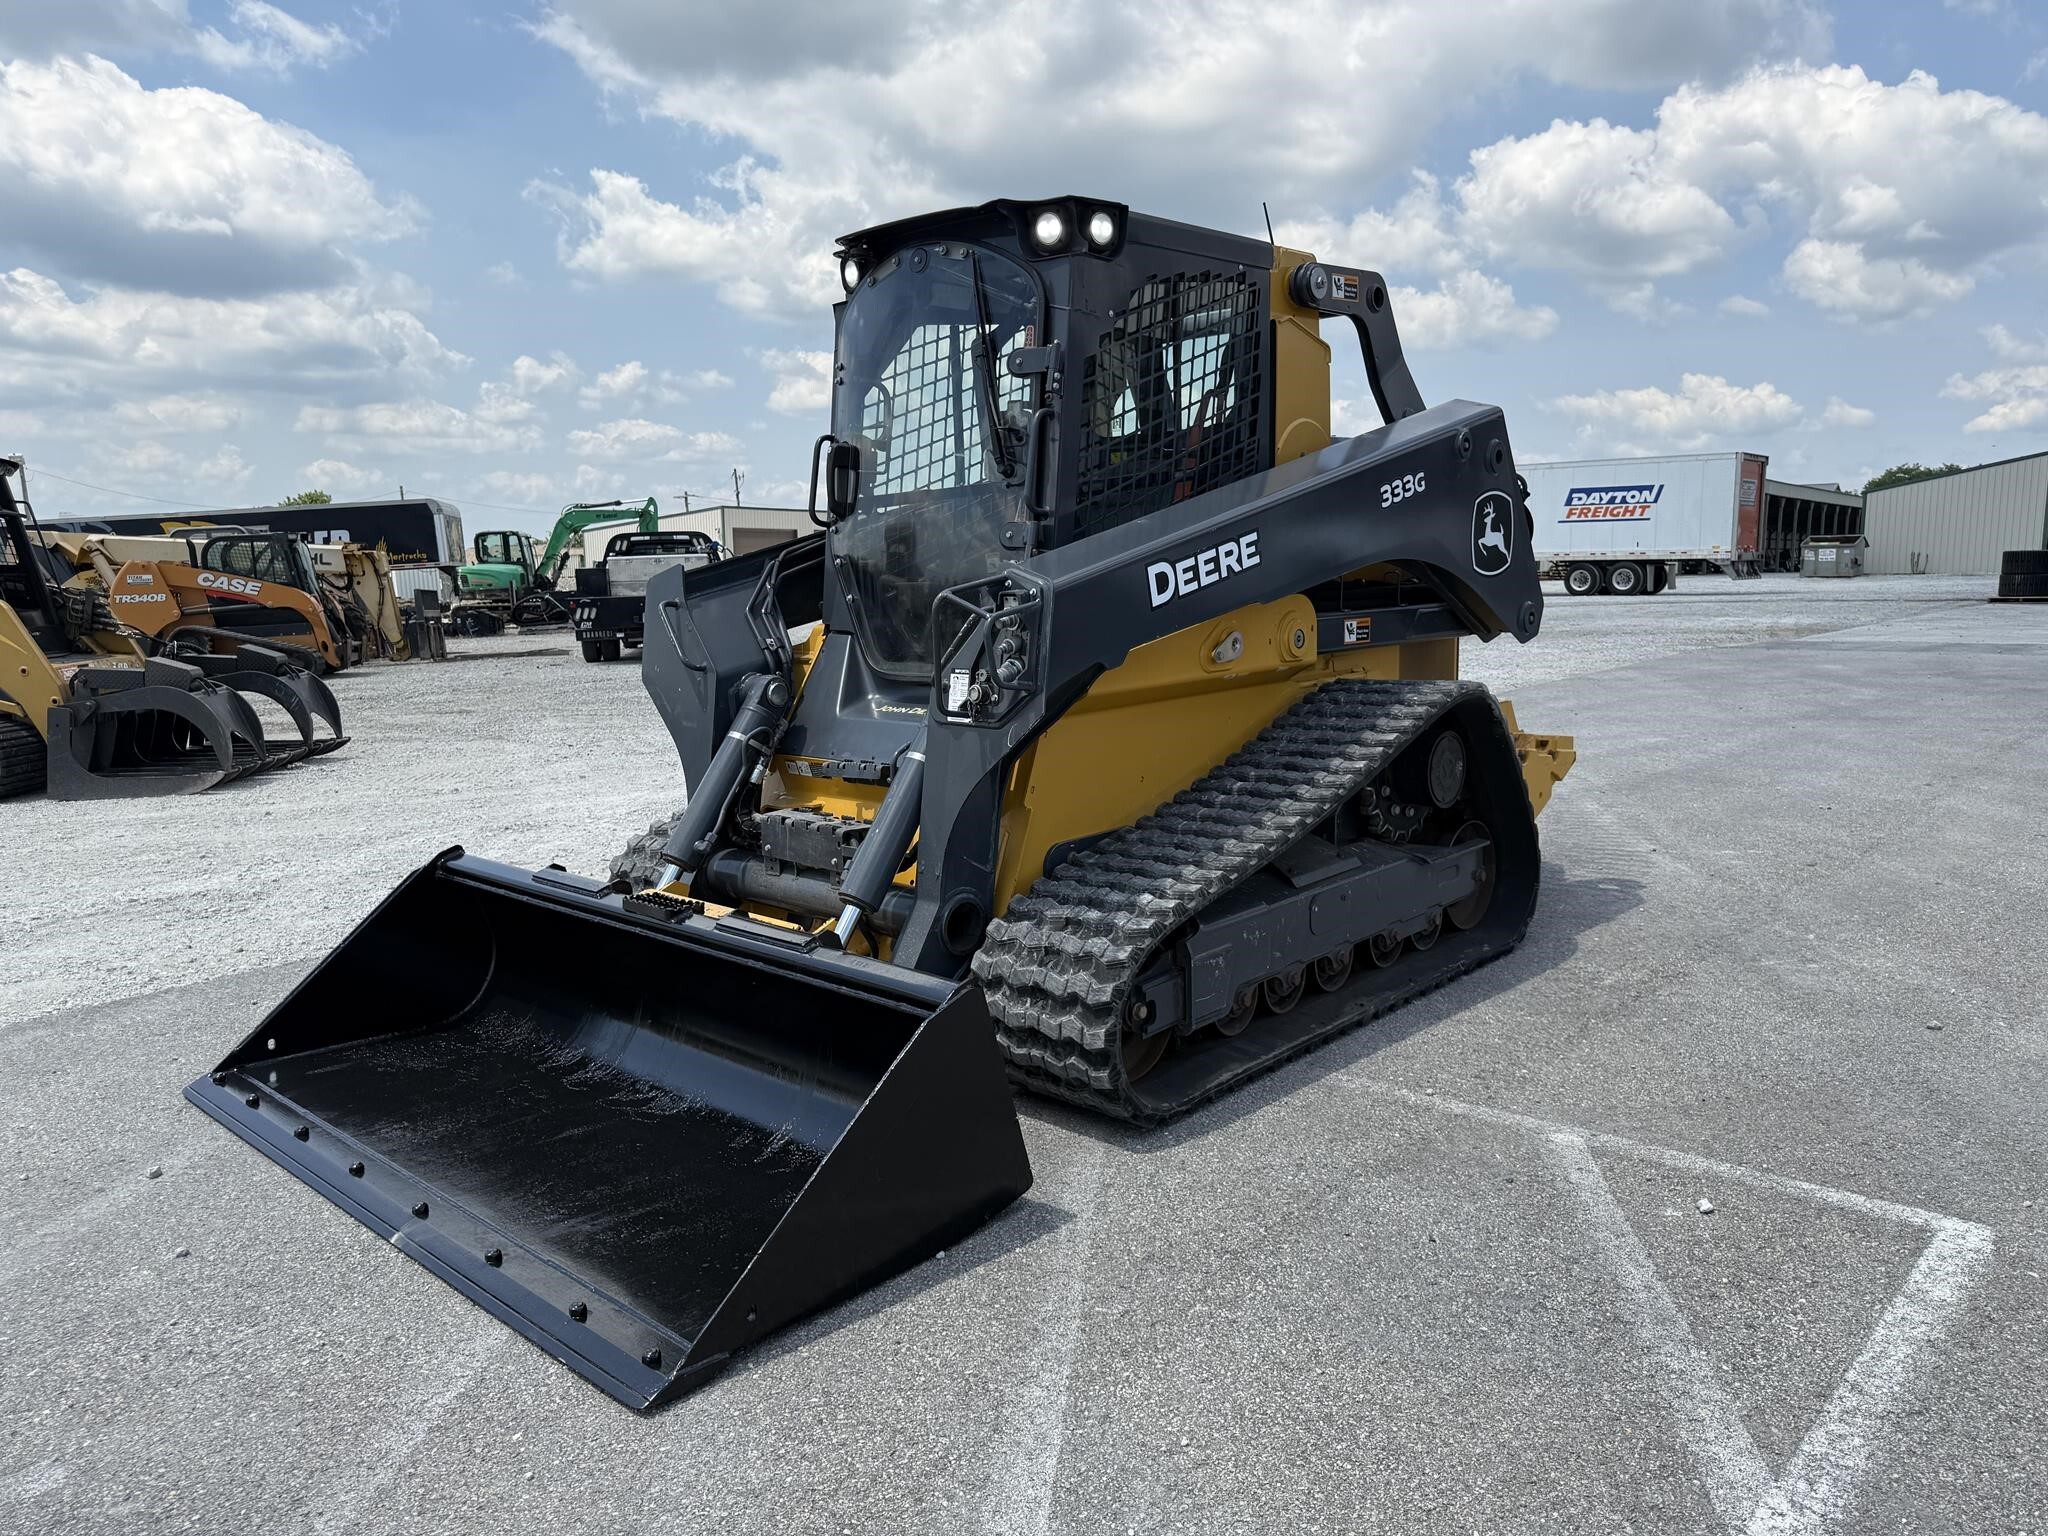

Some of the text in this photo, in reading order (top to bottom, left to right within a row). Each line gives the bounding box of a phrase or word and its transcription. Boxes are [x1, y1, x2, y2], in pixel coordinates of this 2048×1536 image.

[1380, 472, 1426, 508] 333G
[1571, 484, 1656, 505] DAYTON
[1566, 505, 1650, 519] FREIGHT
[1147, 531, 1261, 608] DEERE
[197, 572, 262, 596] CASE
[114, 593, 166, 603] TR340B
